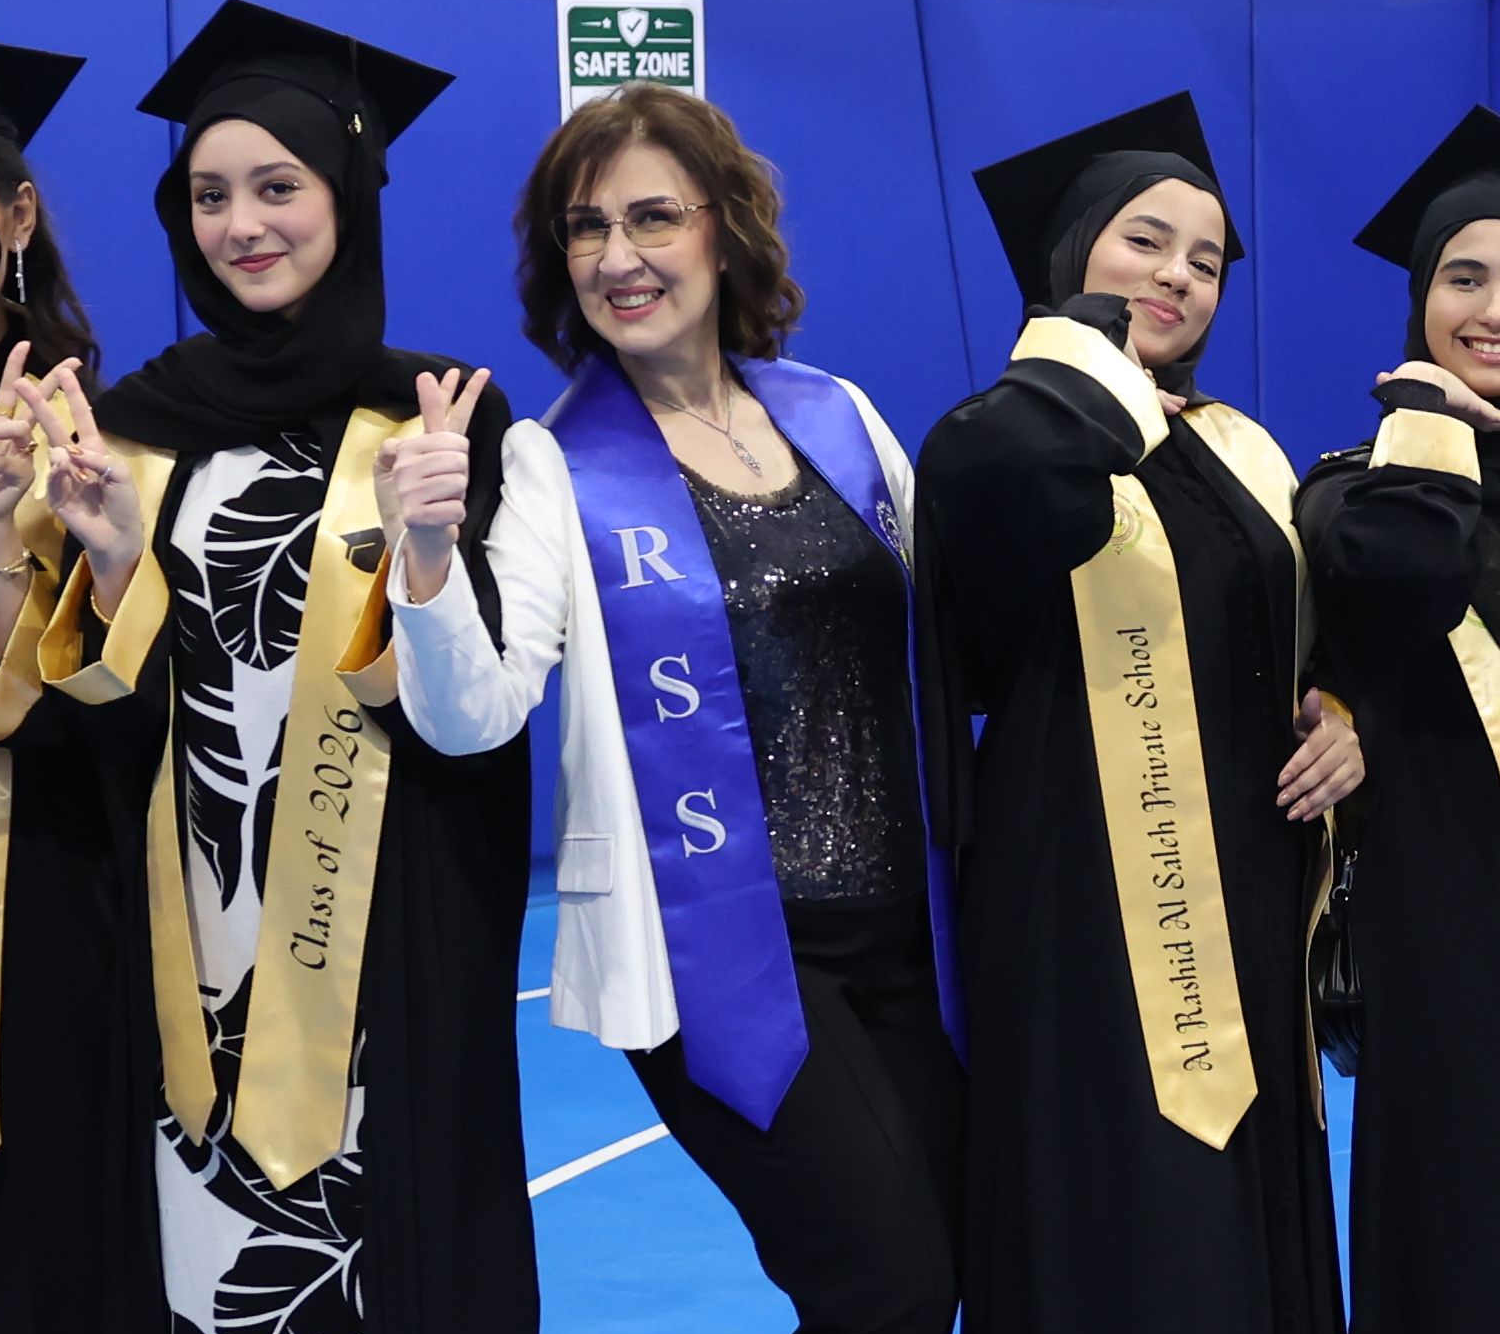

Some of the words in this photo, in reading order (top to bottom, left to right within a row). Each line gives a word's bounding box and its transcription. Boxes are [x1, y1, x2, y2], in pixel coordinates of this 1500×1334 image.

[574, 51, 631, 78] SAFE
[635, 51, 690, 78] ZONE
[1116, 624, 1159, 710] School
[309, 704, 364, 824] 2026
[1140, 720, 1177, 814] Private
[305, 828, 342, 874] of
[1147, 818, 1186, 892] Saleh
[290, 883, 335, 971] Class
[1157, 899, 1191, 931] Al
[1162, 939, 1210, 1036] Rashid
[1182, 1039, 1213, 1073] Al
